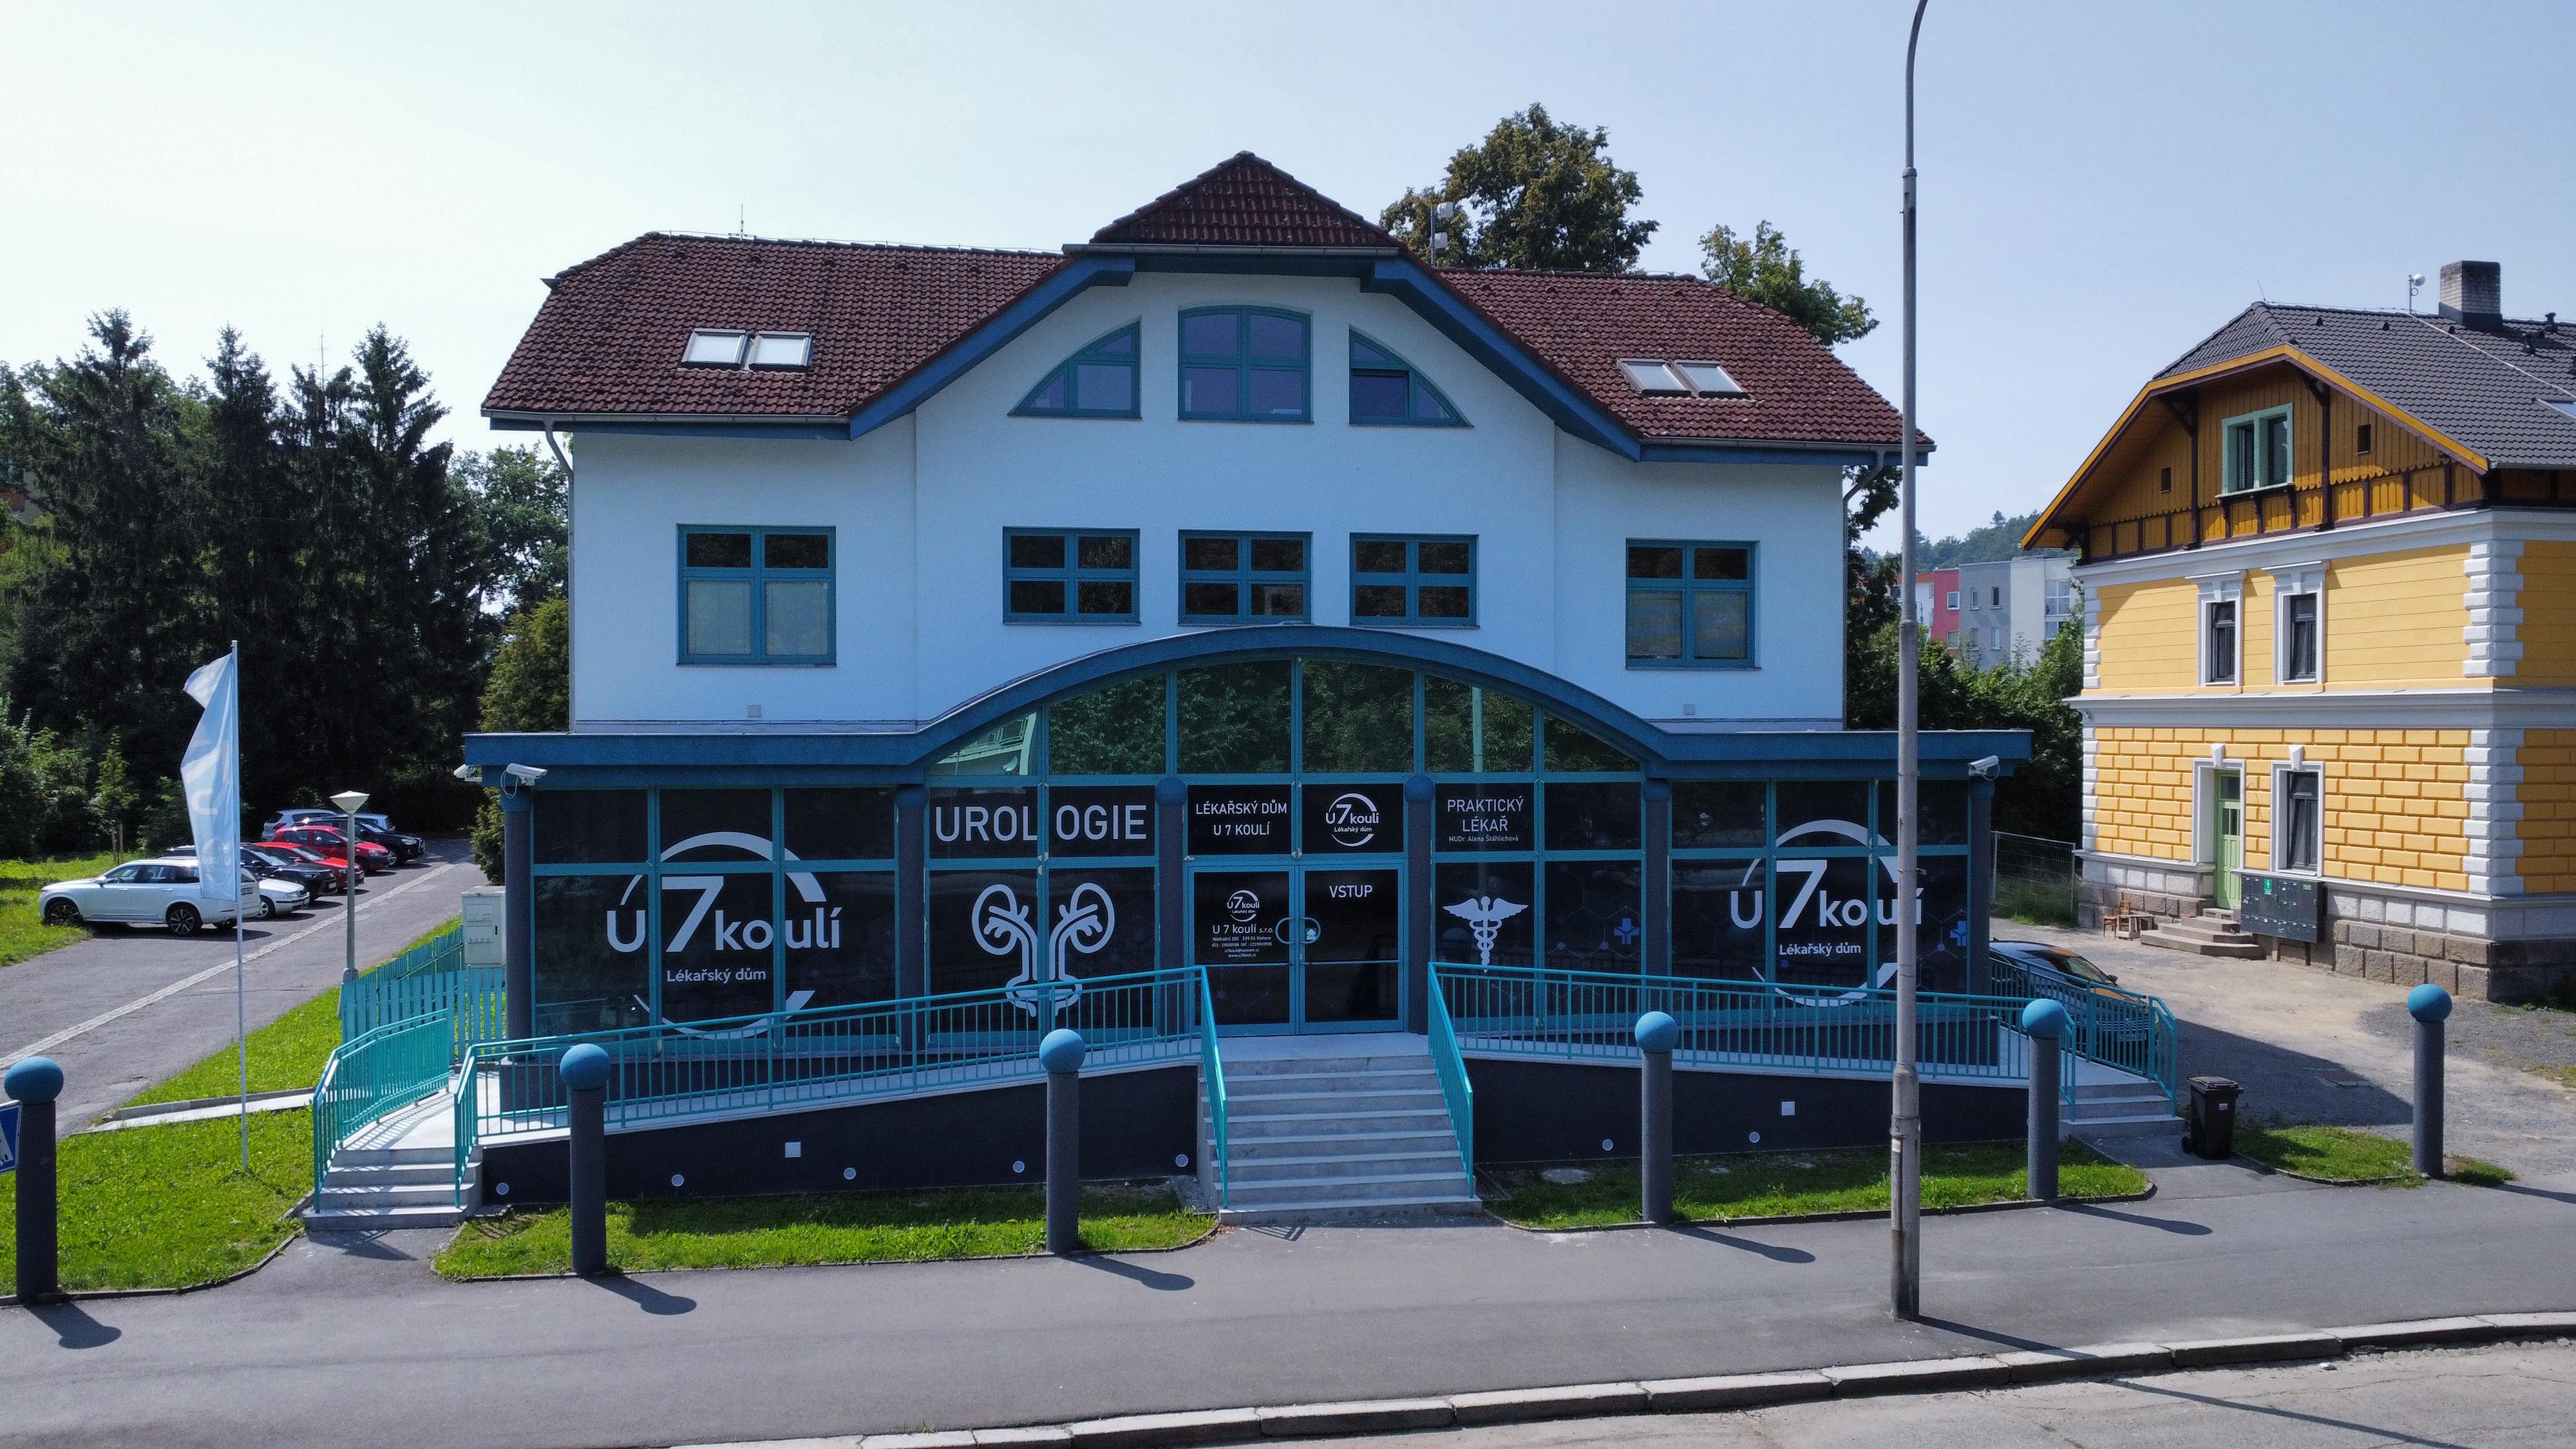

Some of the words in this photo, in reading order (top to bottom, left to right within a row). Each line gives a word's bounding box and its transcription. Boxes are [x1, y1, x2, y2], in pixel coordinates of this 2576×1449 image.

[1196, 800, 1258, 814] LÉKAŘSKÝ
[1262, 799, 1287, 814] DŮM
[1447, 795, 1524, 812] PRAKTICKÝ
[1325, 812, 1336, 824] U
[1336, 804, 1352, 824] 7
[1350, 812, 1379, 824] koulí
[936, 805, 1147, 842] UROLOGIE
[1213, 824, 1222, 835] U
[1225, 824, 1231, 835] 7
[1235, 821, 1271, 835] KOULÍ
[1463, 815, 1508, 832] LÉKAŘ
[1329, 885, 1373, 898] VSTUP
[1730, 890, 1763, 929] U
[1776, 859, 1828, 929] 7
[1819, 887, 1925, 927] kouí
[1233, 896, 1244, 909] 7
[607, 910, 646, 953] U
[661, 876, 724, 953] 7
[715, 907, 843, 951] koulí
[1212, 925, 1220, 934] U
[1223, 925, 1229, 934] 7
[1232, 923, 1257, 934] koulí
[1779, 942, 1833, 957] Lékařský
[1836, 942, 1862, 955] dům
[667, 968, 731, 985] Lékařský
[735, 968, 766, 981] dům
